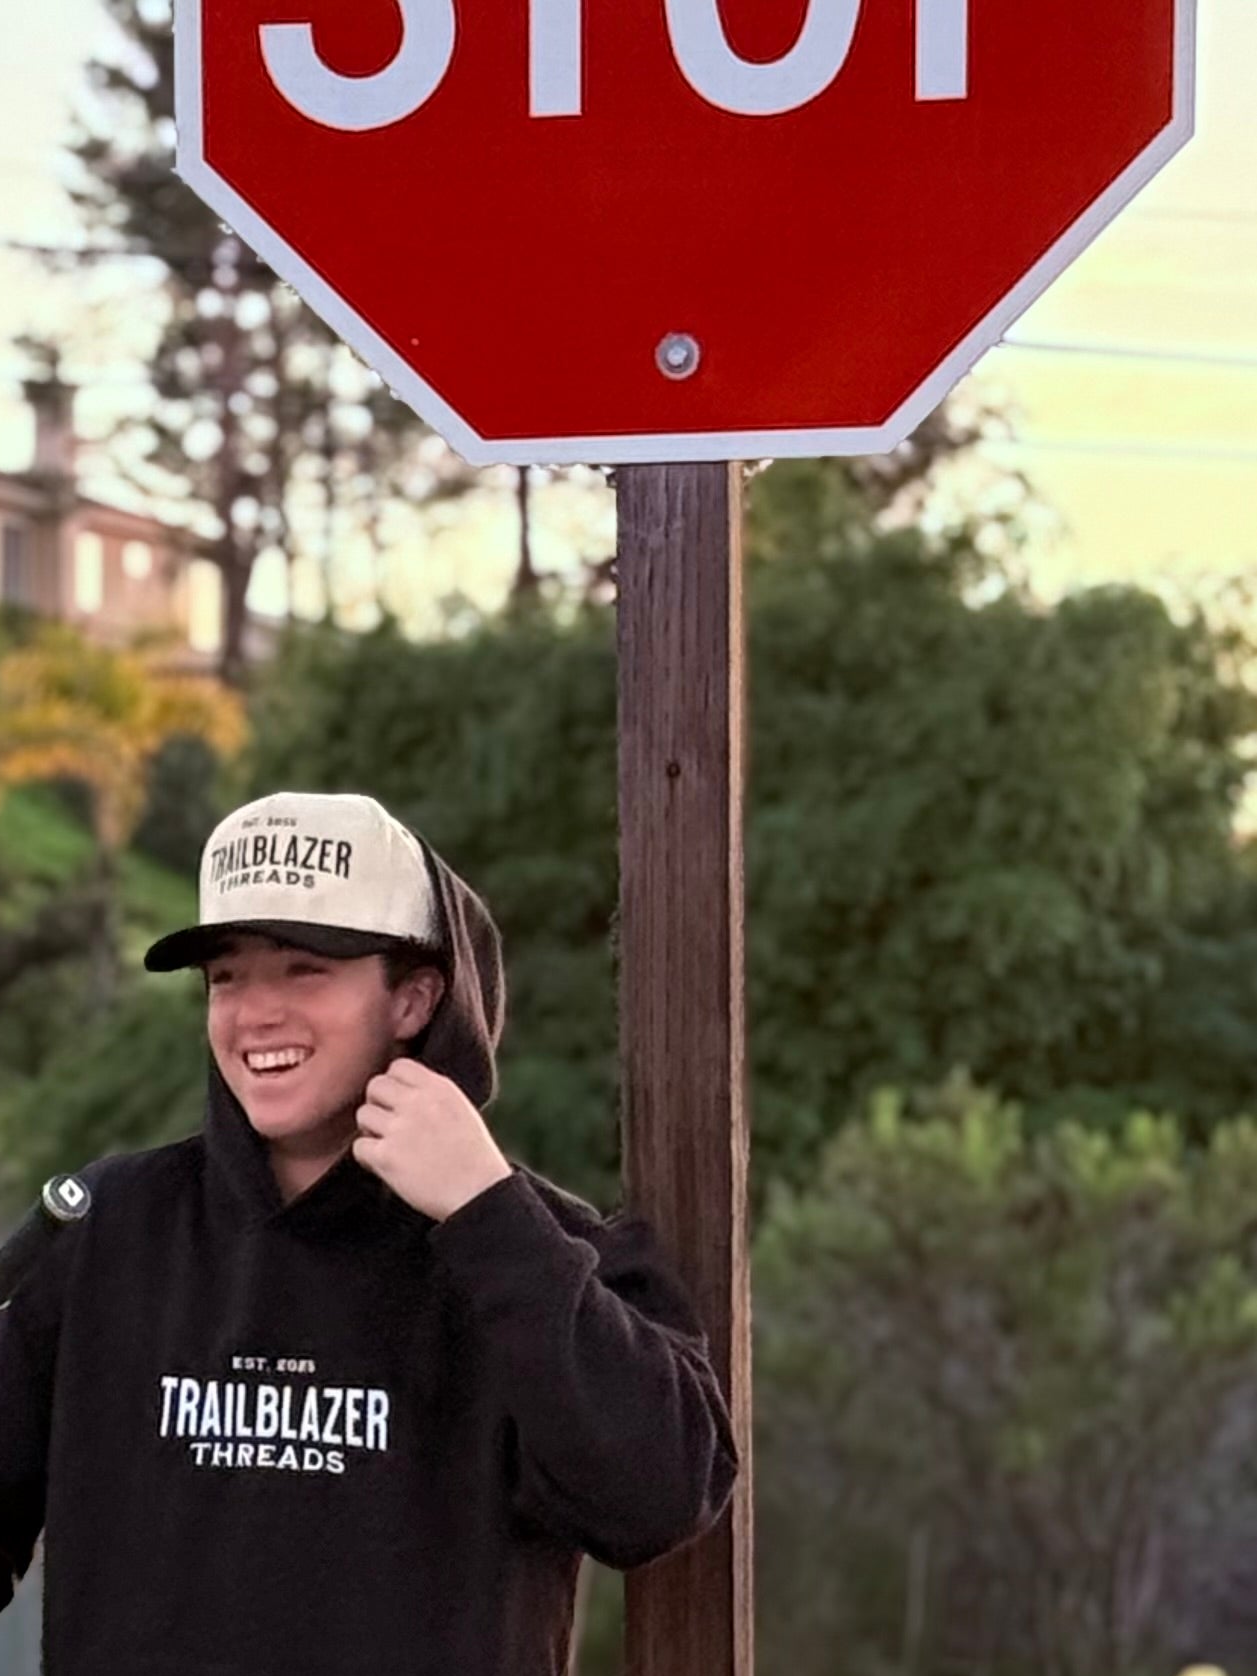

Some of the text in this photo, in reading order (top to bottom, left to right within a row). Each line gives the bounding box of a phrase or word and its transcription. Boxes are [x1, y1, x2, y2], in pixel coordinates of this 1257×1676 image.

[211, 834, 352, 881] TRAILBLAZER
[218, 869, 315, 894] THREADS
[160, 1376, 390, 1450] TRAILBLAZER
[189, 1442, 345, 1474] THREADS
